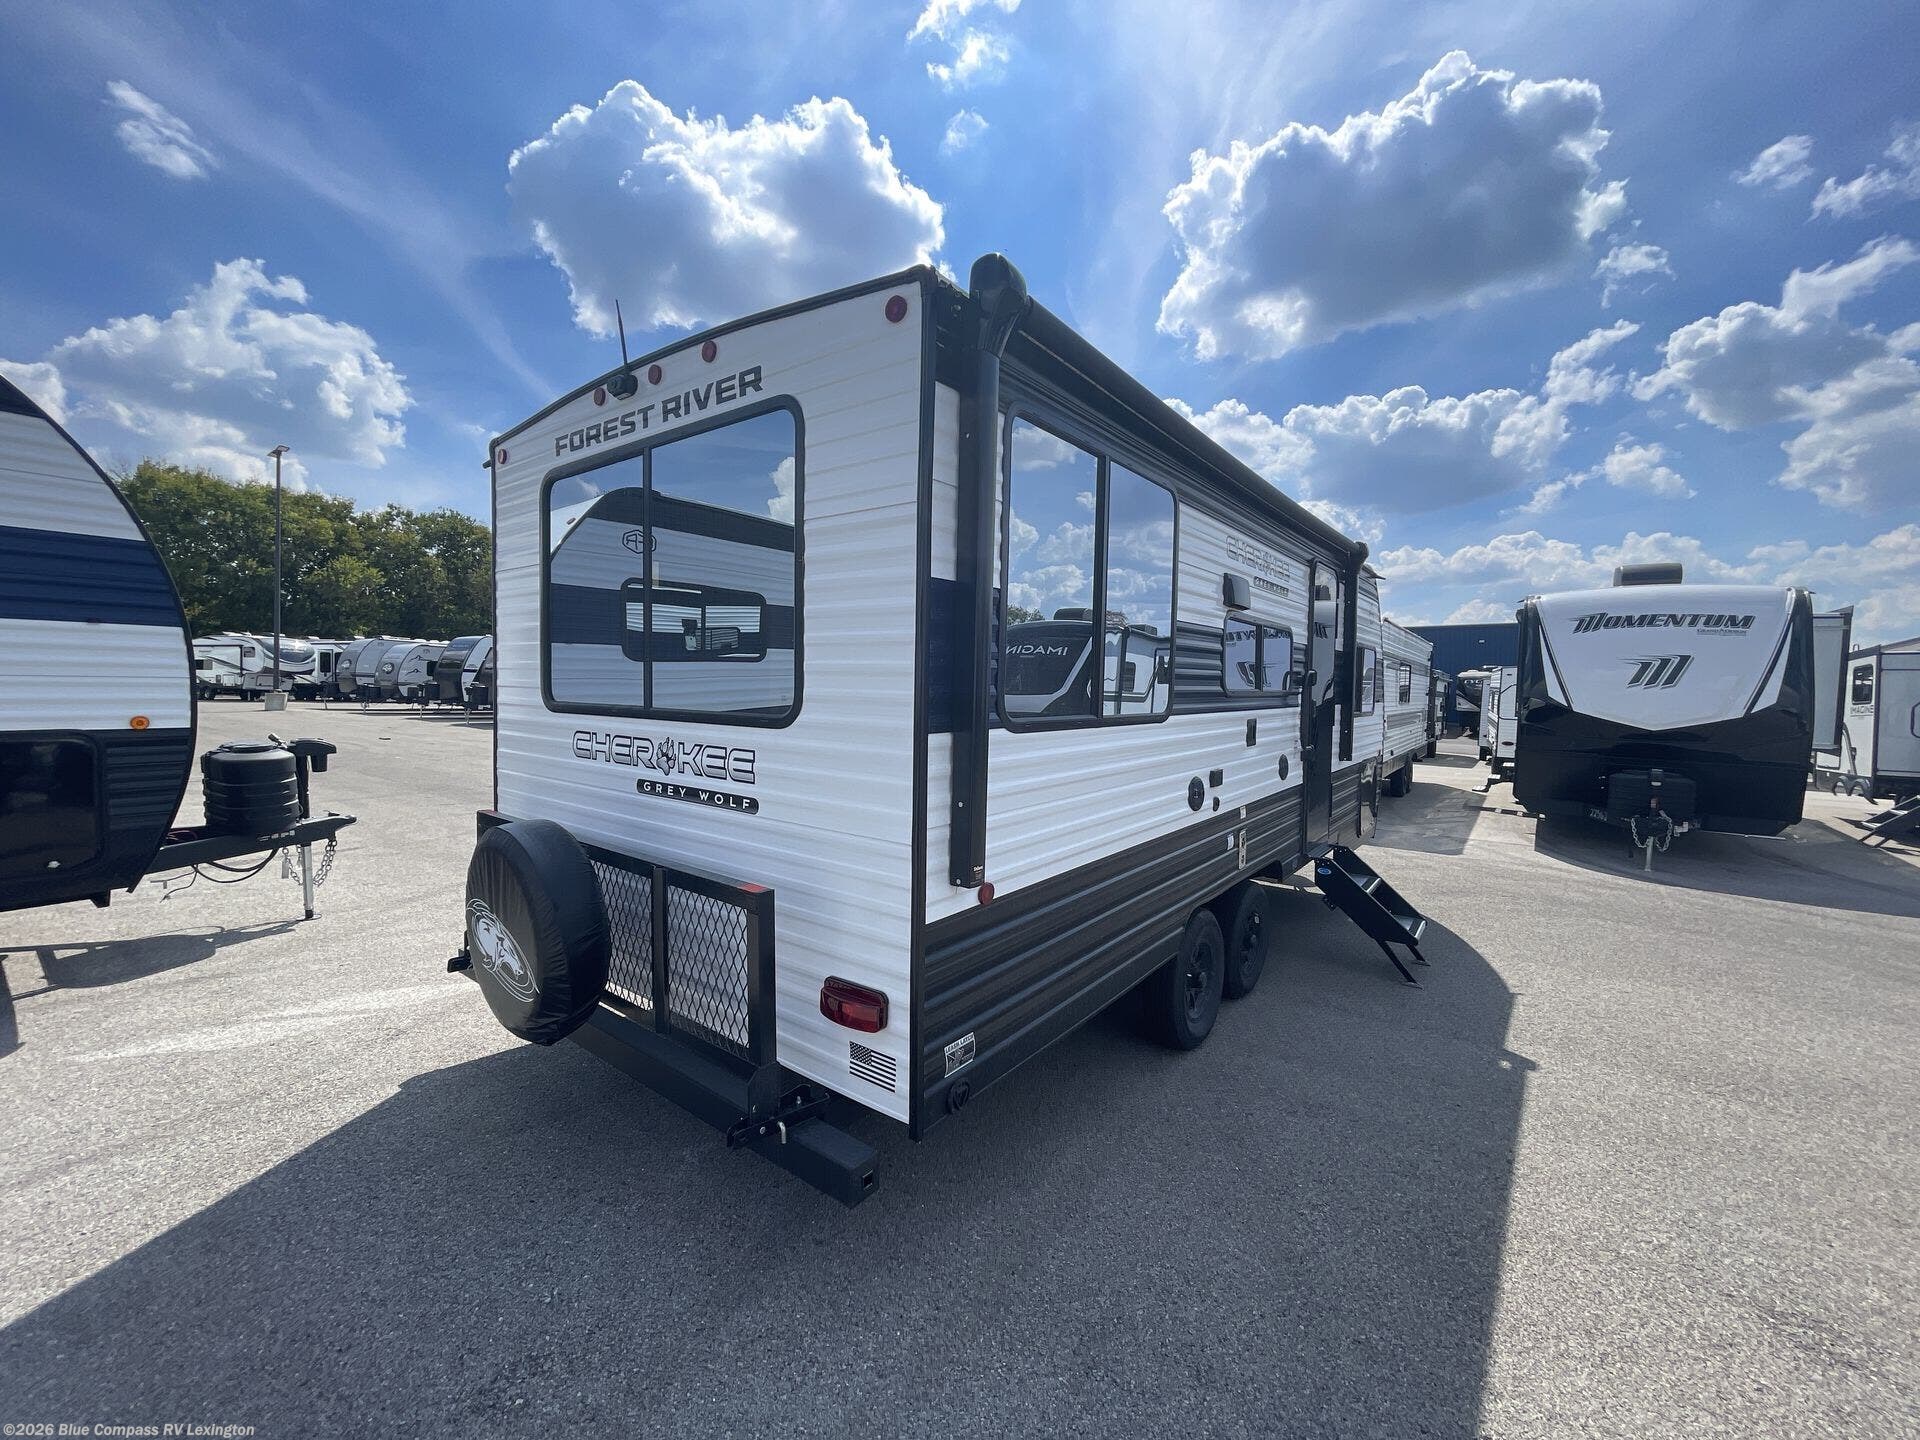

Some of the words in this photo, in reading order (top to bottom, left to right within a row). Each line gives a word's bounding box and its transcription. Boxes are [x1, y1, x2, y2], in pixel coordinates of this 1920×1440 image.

[554, 404, 655, 457] FOREST
[661, 365, 763, 423] RIVER
[1571, 612, 1756, 634] MOMENTUM
[573, 730, 756, 784] CHEROKEE
[643, 782, 687, 798] GREY
[699, 790, 751, 809] WOLF
